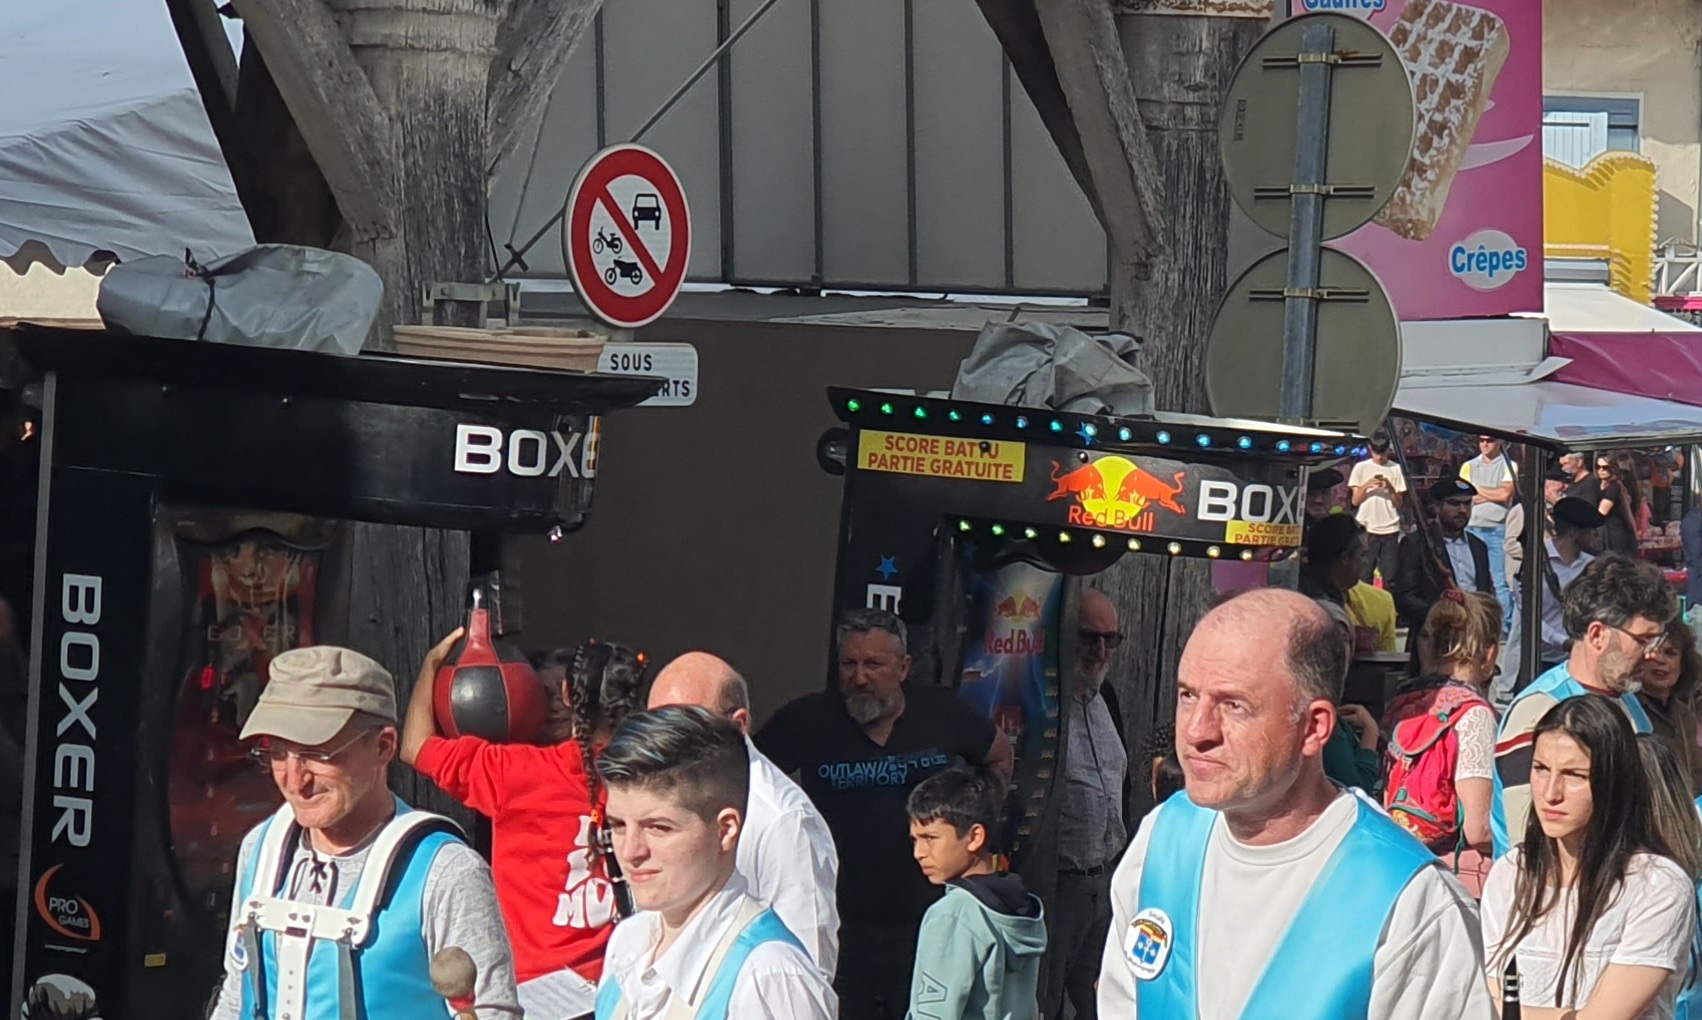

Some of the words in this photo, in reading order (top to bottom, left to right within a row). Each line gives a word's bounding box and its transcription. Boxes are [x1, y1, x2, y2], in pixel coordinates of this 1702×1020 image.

[1452, 244, 1526, 278] Crêpes
[610, 353, 652, 371] SOUS
[654, 380, 690, 397] RTS
[884, 434, 940, 455] SCORE
[867, 452, 926, 473] PARTIE
[929, 458, 1014, 480] GRATUITE
[1068, 504, 1108, 527] Red
[1113, 509, 1154, 532] Bull
[1248, 523, 1284, 535] SCORE
[984, 628, 1014, 655] Red
[51, 573, 102, 847] BOXER
[49, 897, 79, 915] PRO
